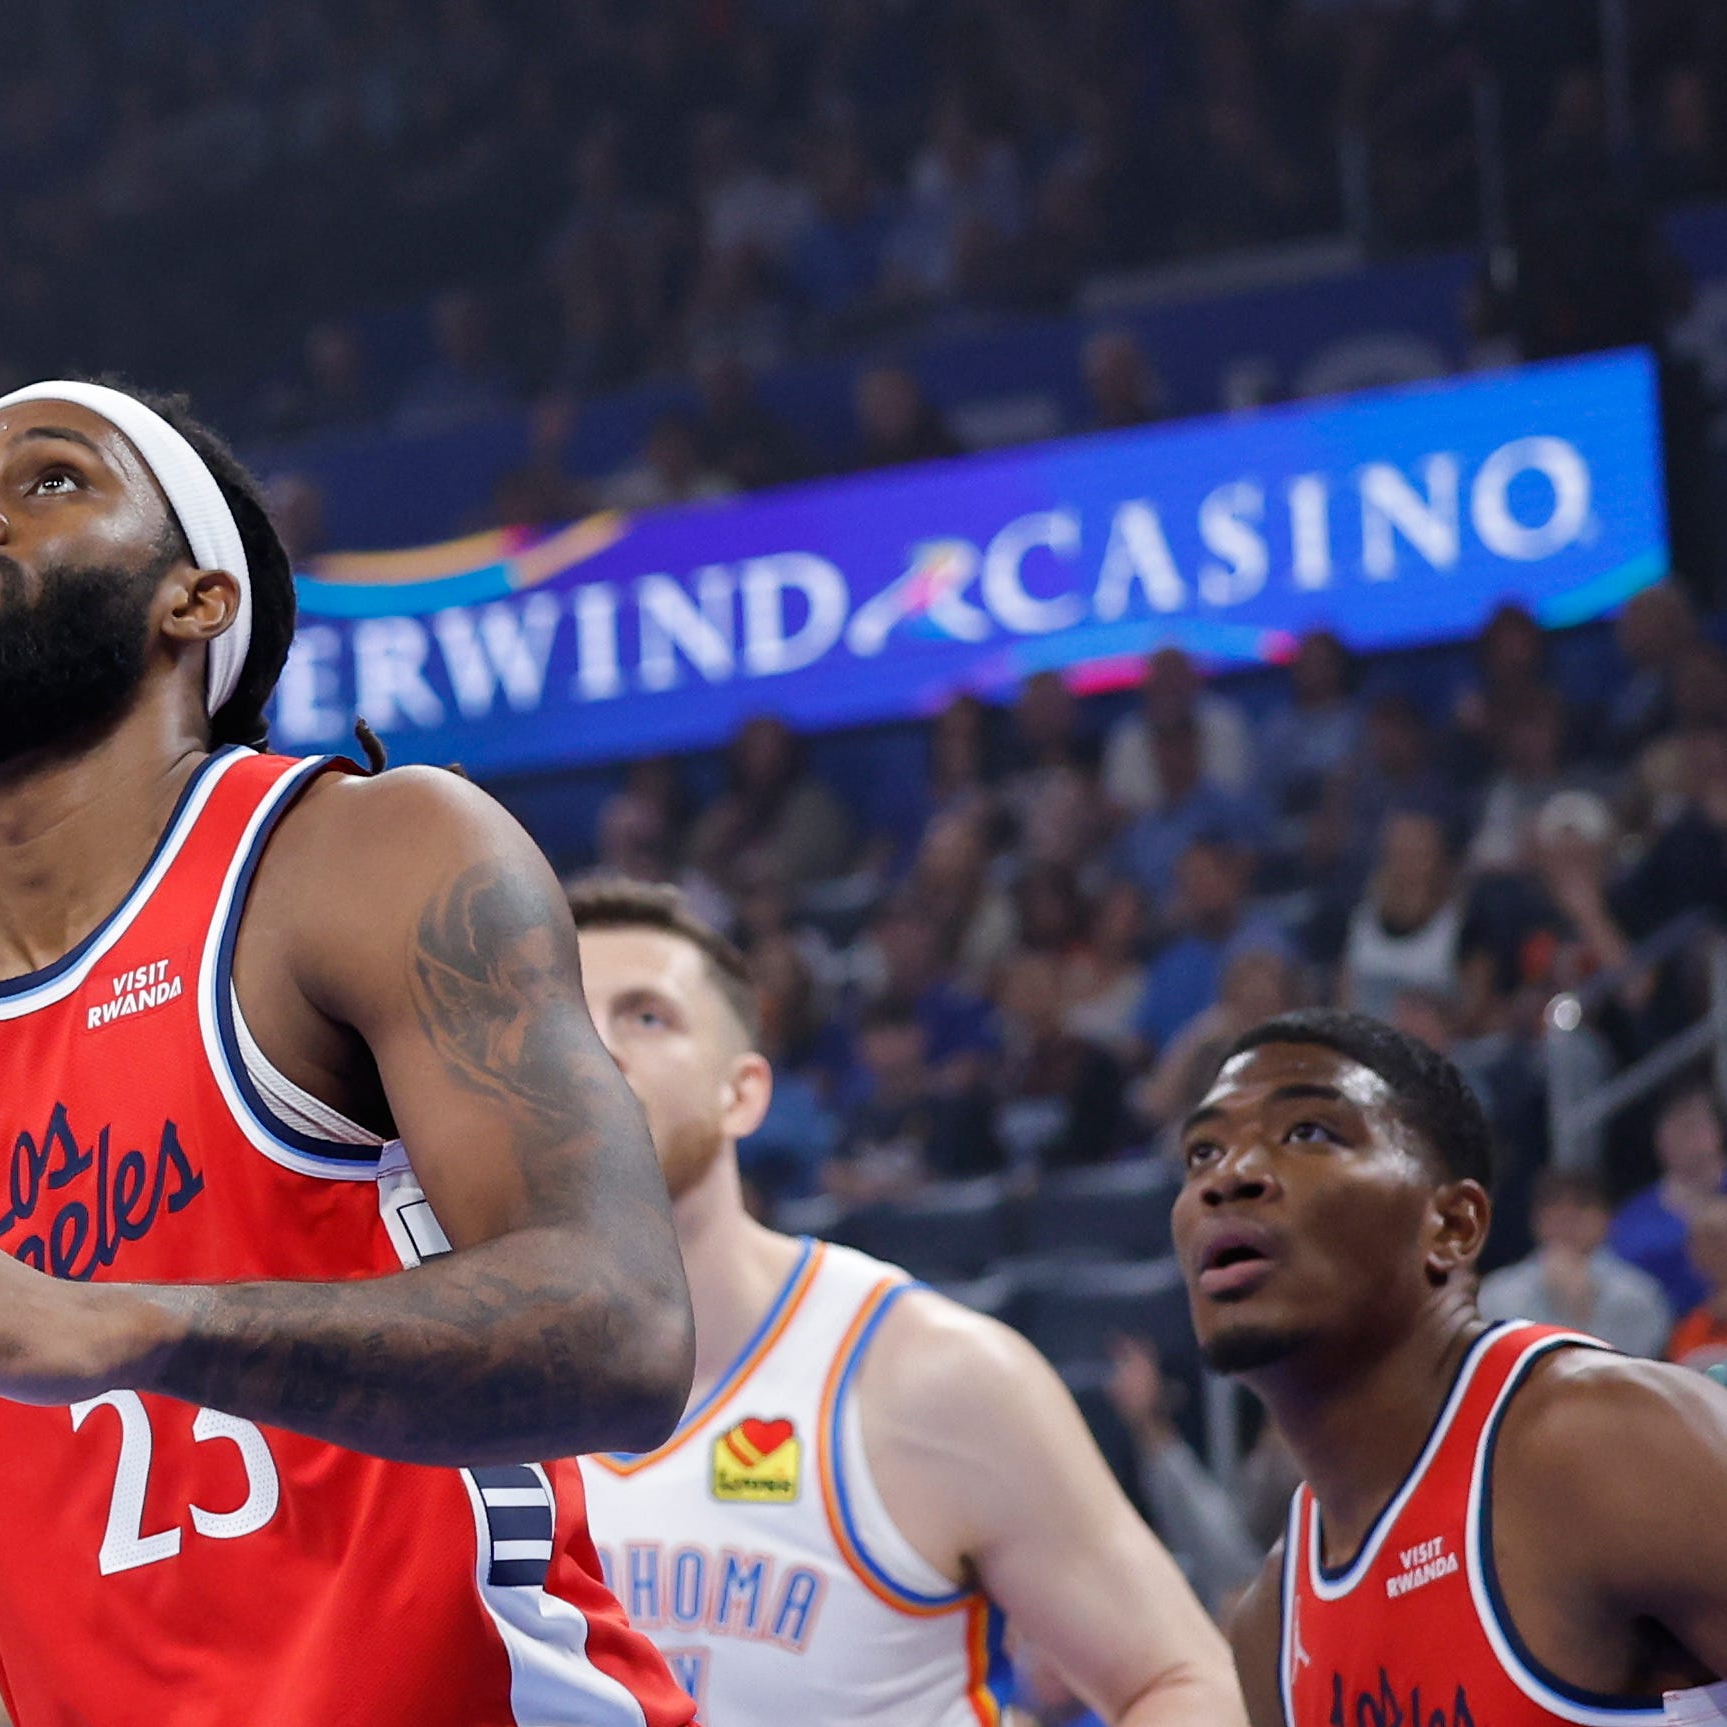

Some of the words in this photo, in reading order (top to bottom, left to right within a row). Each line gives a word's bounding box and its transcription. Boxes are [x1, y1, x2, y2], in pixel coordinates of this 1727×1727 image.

[279, 550, 847, 745] ERWIND
[981, 435, 1593, 636] CASINO
[112, 959, 169, 997] VISIT
[87, 975, 183, 1030] RWANDA
[1386, 1552, 1460, 1599] RWANDA
[1399, 1536, 1444, 1570] VISIT
